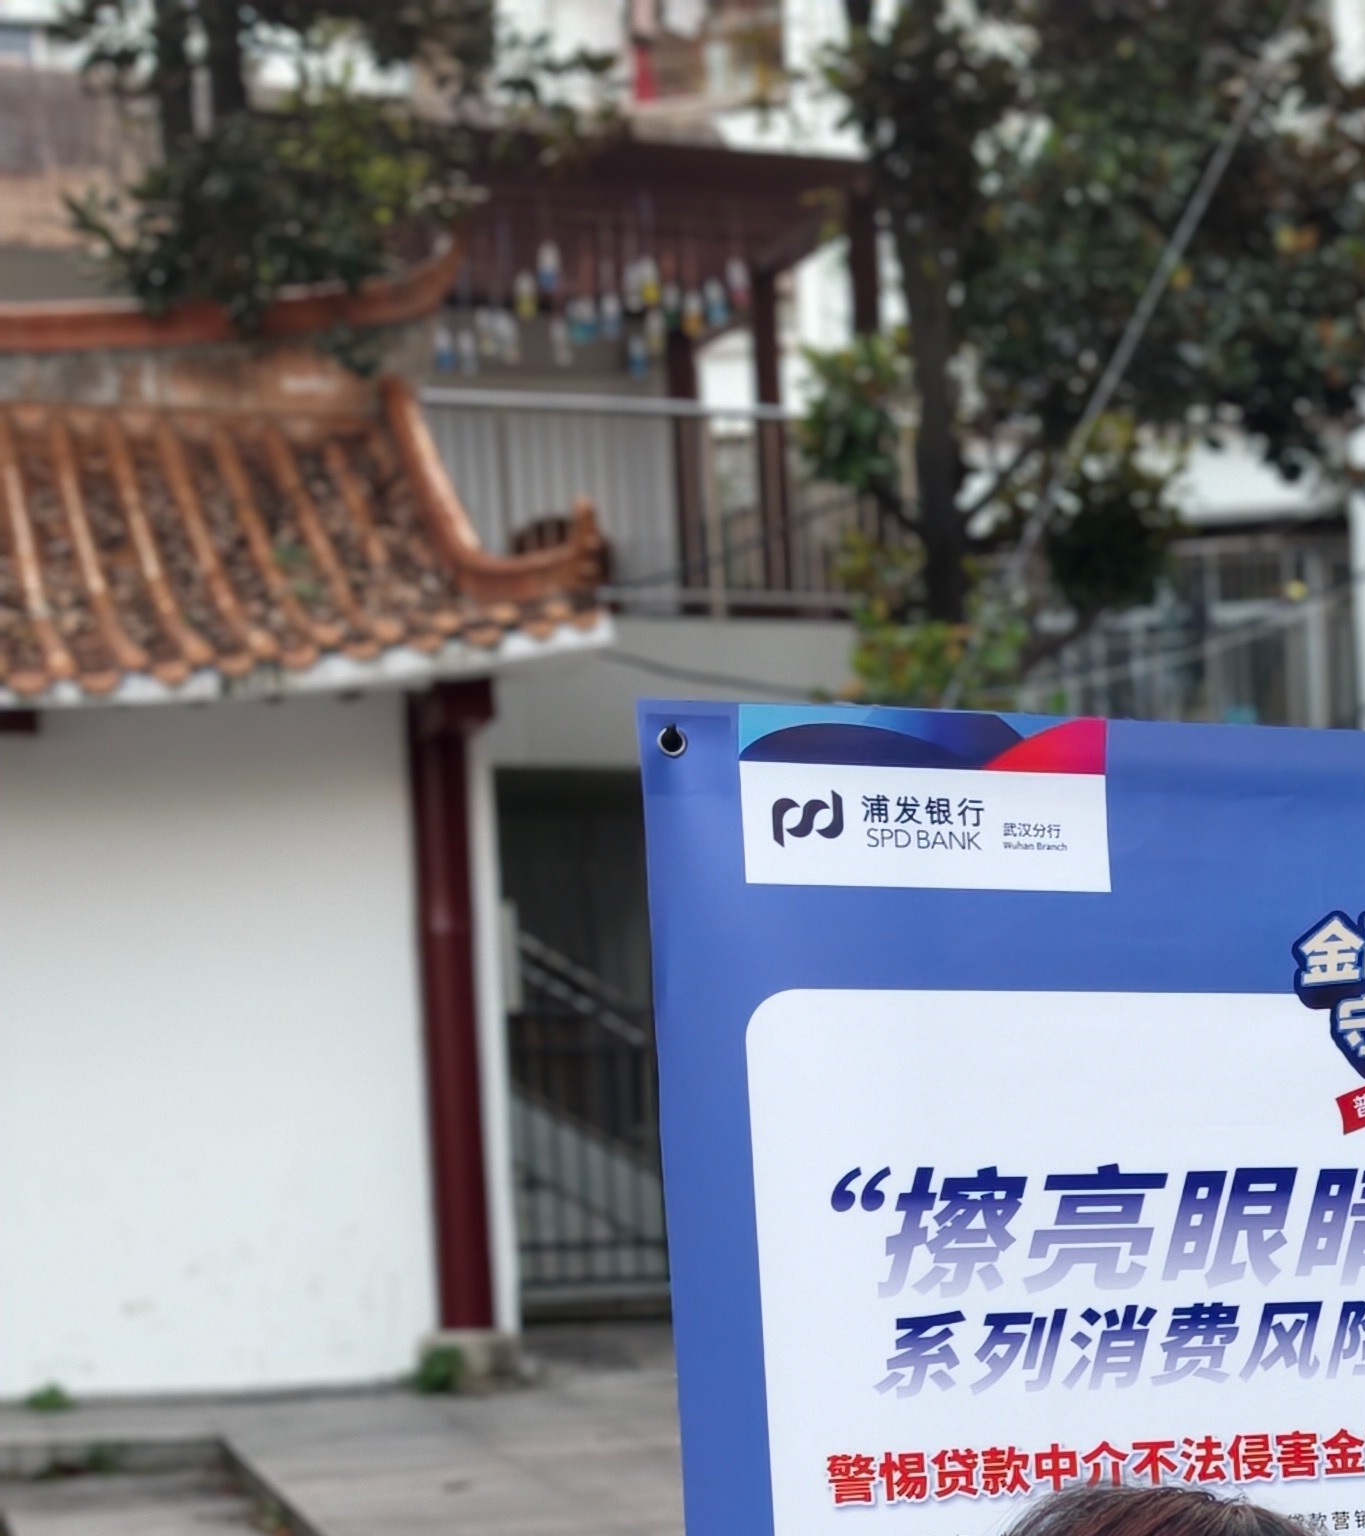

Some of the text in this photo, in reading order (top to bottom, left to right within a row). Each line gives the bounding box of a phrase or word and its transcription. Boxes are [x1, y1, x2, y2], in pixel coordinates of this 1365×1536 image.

[862, 794, 985, 827] 浦发银行
[867, 828, 983, 851] SPD BANK
[1003, 822, 1061, 839] 武汉分行
[1003, 841, 1068, 852] Wuhan Branch
